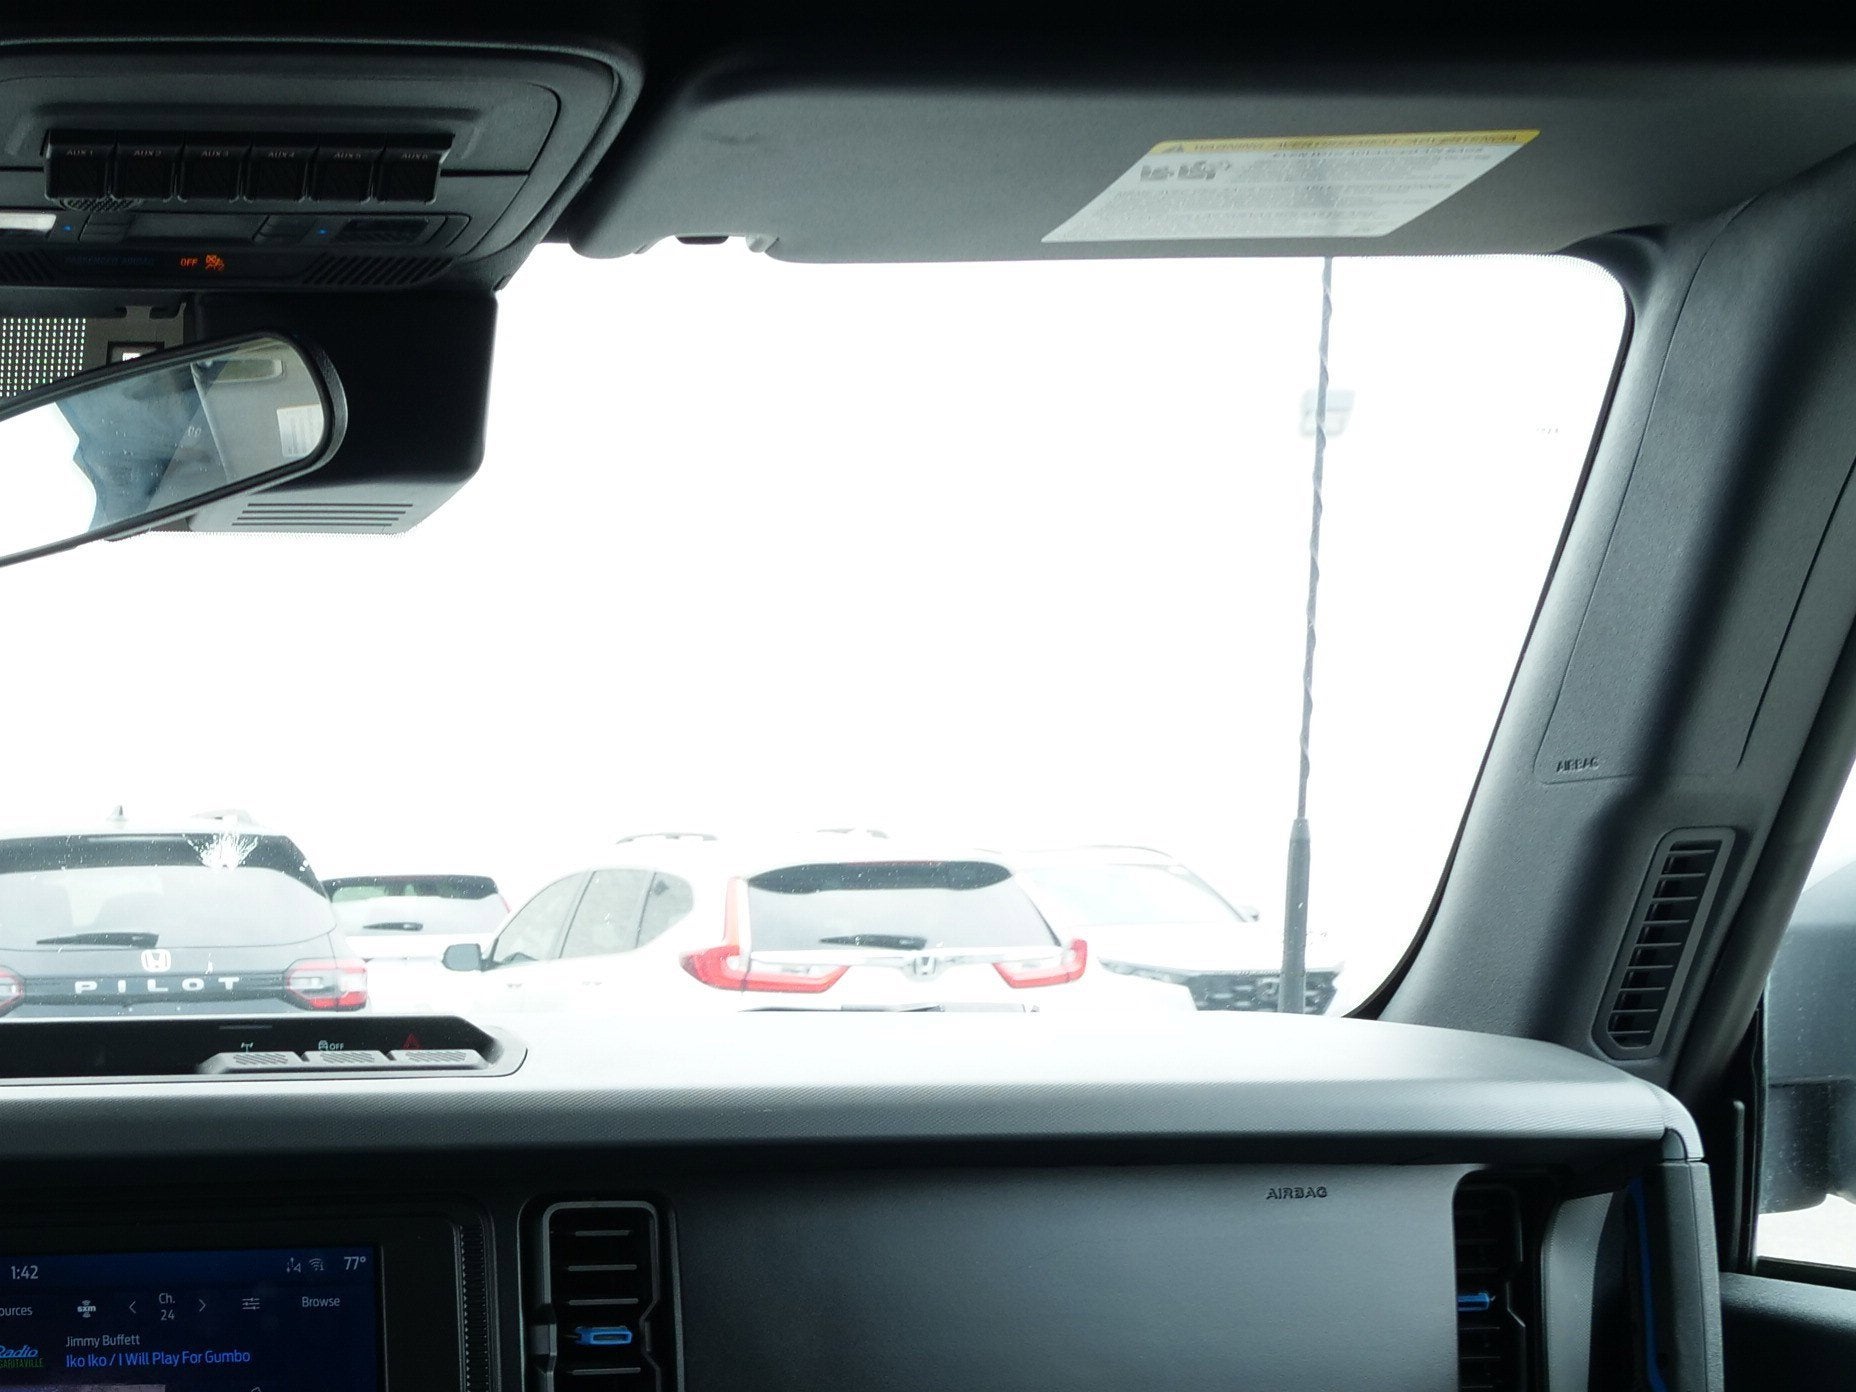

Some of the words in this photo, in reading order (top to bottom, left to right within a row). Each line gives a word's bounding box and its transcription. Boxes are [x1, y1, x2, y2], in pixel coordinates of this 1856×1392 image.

[74, 976, 240, 994] PILOT
[329, 1042, 344, 1050] OFF
[1266, 1186, 1328, 1200] AIRBAG
[344, 1256, 367, 1270] 77°
[10, 1265, 39, 1280] 1:42
[158, 1293, 176, 1304] Ch.
[301, 1296, 340, 1308] Browse
[160, 1309, 175, 1321] 24
[66, 1335, 99, 1349] Jimmy
[102, 1334, 140, 1346] Buffett
[66, 1354, 84, 1367] Iko
[88, 1354, 107, 1367] Iko
[124, 1352, 149, 1366] Will
[153, 1351, 179, 1367] Play
[182, 1350, 203, 1364] For
[205, 1349, 251, 1364] Gumbo
